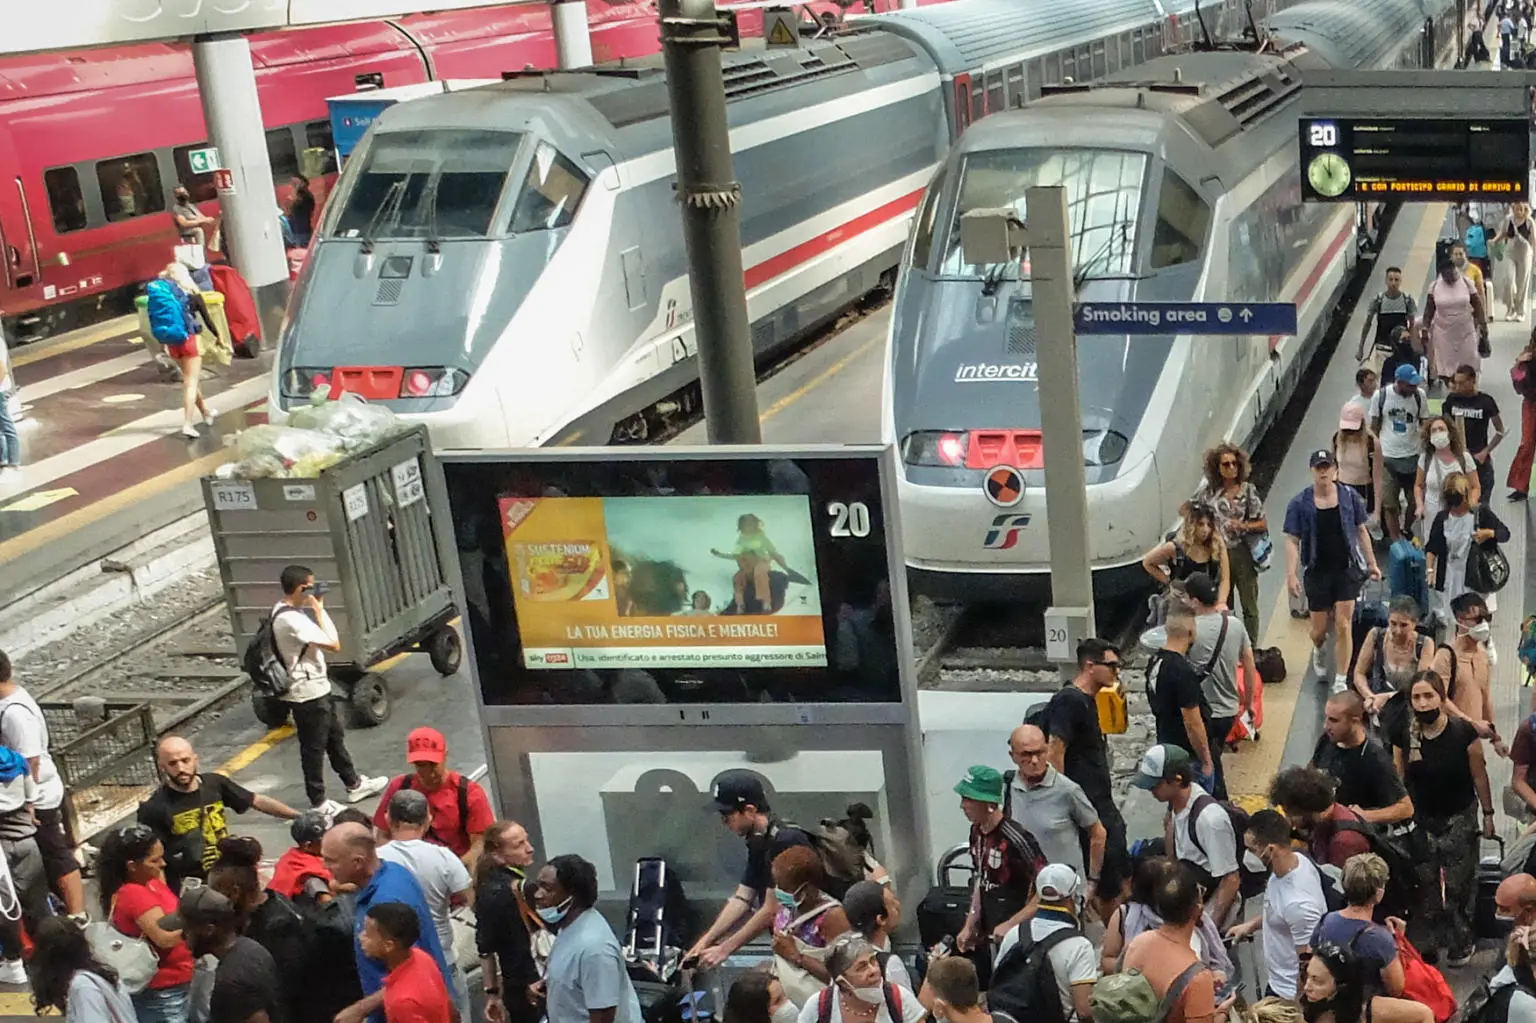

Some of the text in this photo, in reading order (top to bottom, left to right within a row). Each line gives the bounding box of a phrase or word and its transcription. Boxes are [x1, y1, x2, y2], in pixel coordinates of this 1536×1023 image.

[1310, 124, 1336, 146] 20
[1083, 306, 1207, 326] Smoking area
[955, 362, 1038, 382] intercit
[219, 491, 250, 503] R175
[828, 502, 870, 537] 20
[566, 623, 778, 640] LA TUA ENERGIA FISICA E MENTALE!
[1049, 628, 1067, 642] 20
[598, 653, 650, 662] identificato
[659, 653, 701, 662] arrestato
[702, 653, 743, 662] presunto
[744, 653, 793, 662] aggressore
[794, 652, 804, 660] di
